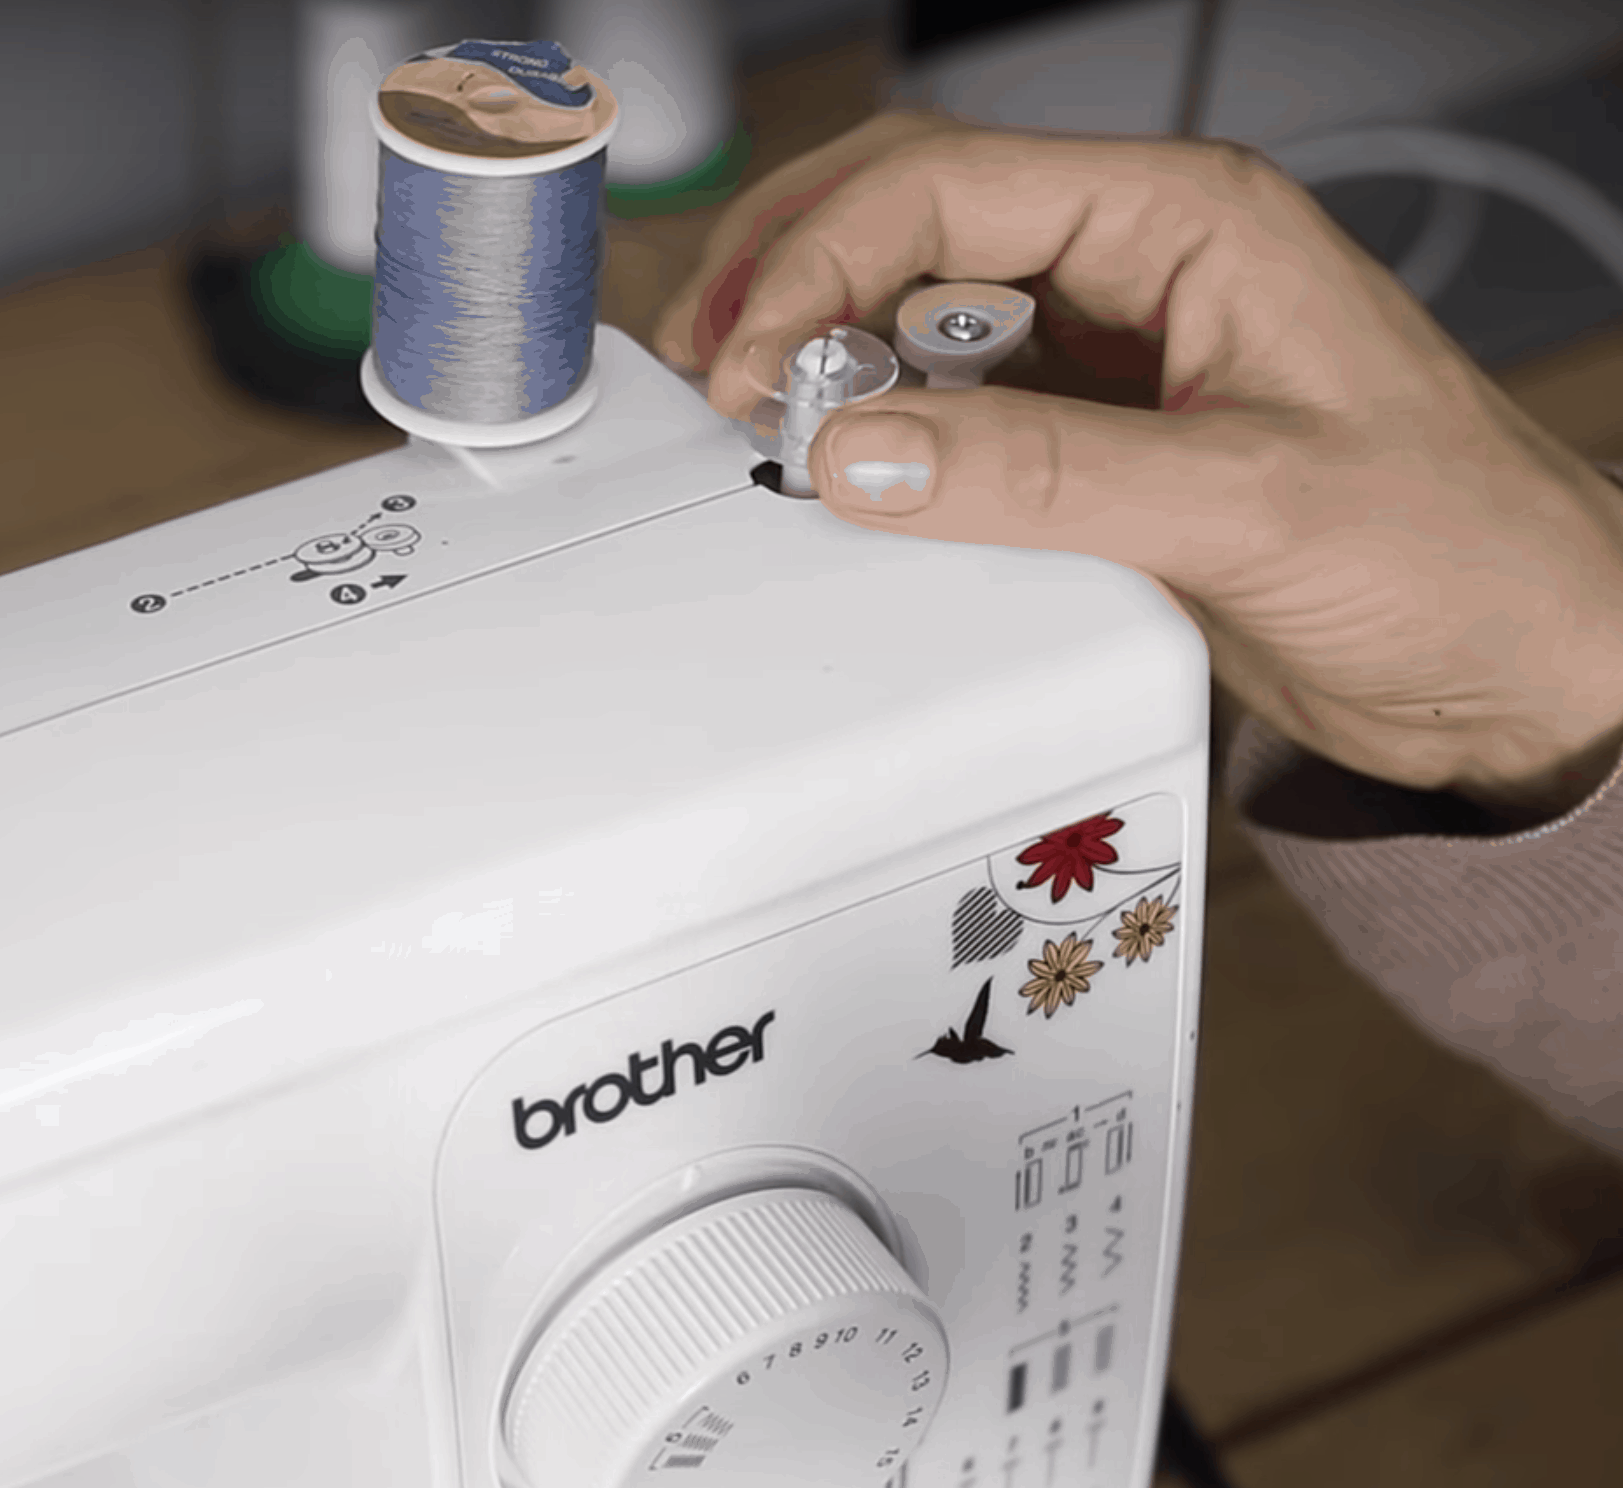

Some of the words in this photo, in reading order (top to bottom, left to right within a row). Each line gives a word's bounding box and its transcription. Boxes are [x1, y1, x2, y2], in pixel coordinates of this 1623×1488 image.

[511, 1008, 776, 1150] brother
[1071, 1104, 1080, 1122] 1
[813, 1332, 829, 1350] 9
[834, 1326, 859, 1343] 10
[875, 1327, 898, 1345] 11
[788, 1341, 803, 1358] 8
[901, 1341, 924, 1363] 12
[911, 1369, 931, 1391] 13
[901, 1406, 924, 1428] 14
